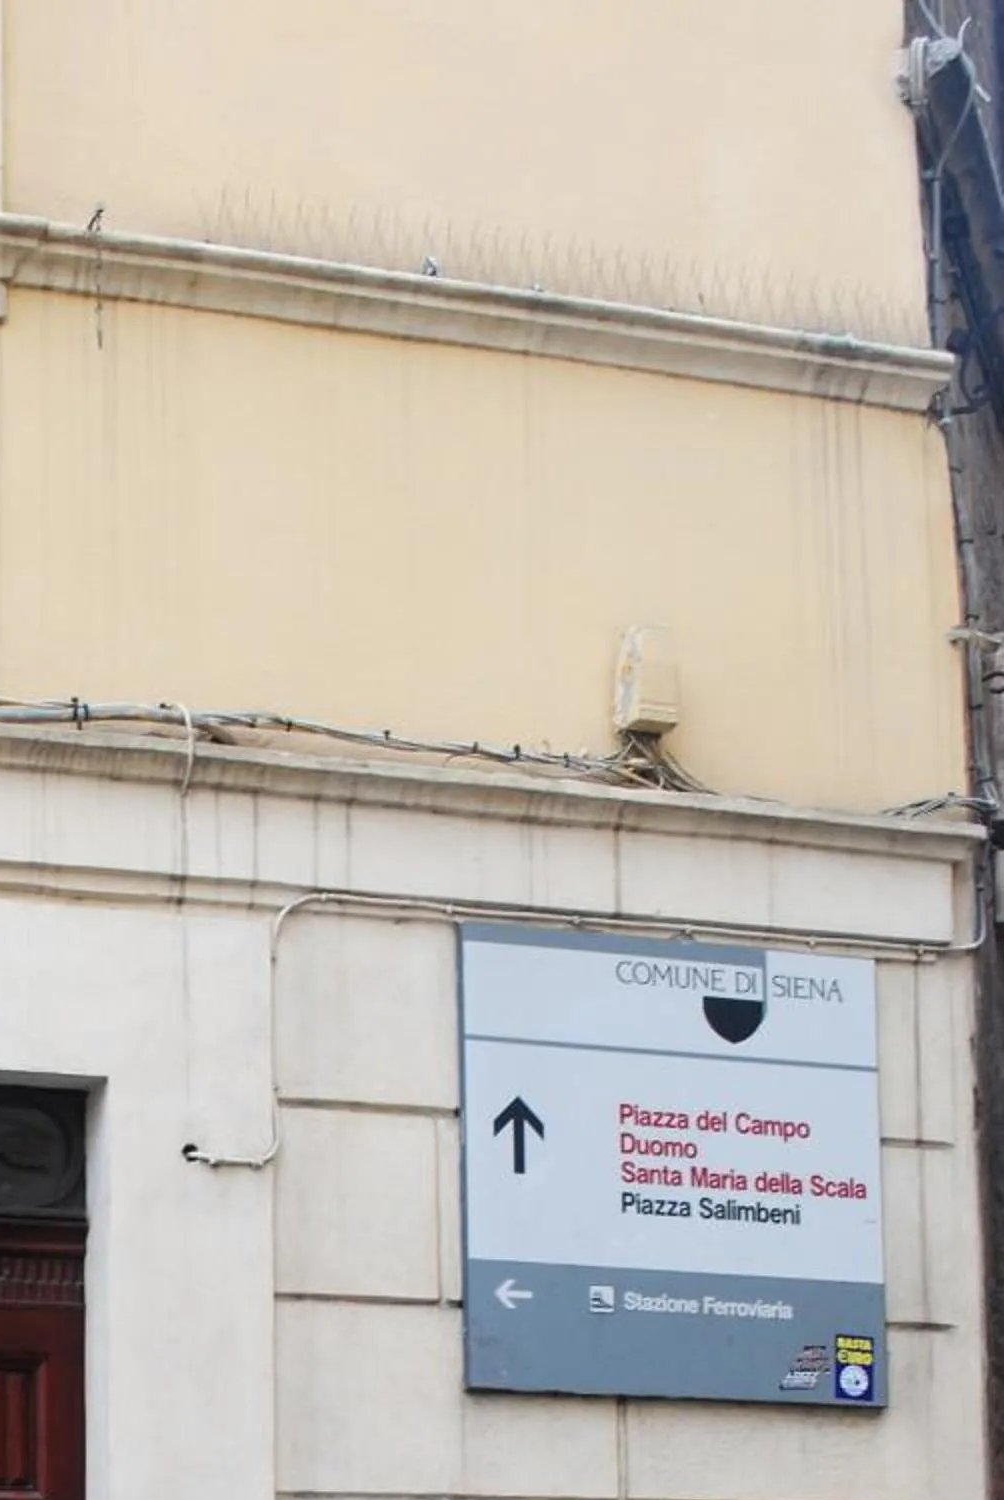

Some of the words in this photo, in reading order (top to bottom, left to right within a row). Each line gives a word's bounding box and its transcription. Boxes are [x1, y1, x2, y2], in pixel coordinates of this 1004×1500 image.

[615, 960, 726, 992] COMUNE
[734, 971, 757, 994] DI
[772, 975, 844, 1003] SIENA
[619, 1103, 689, 1129] Piazza
[696, 1111, 727, 1133] del
[735, 1113, 810, 1143] Campo
[620, 1133, 697, 1158] Duomo
[621, 1161, 683, 1186] Santa
[690, 1166, 747, 1191] Maria
[755, 1172, 803, 1196] della
[810, 1175, 867, 1199] Scala
[621, 1192, 691, 1217] Piazza
[699, 1198, 801, 1225] Salimbeni
[624, 1291, 698, 1313] Stazione
[703, 1296, 794, 1319] Ferroviaria
